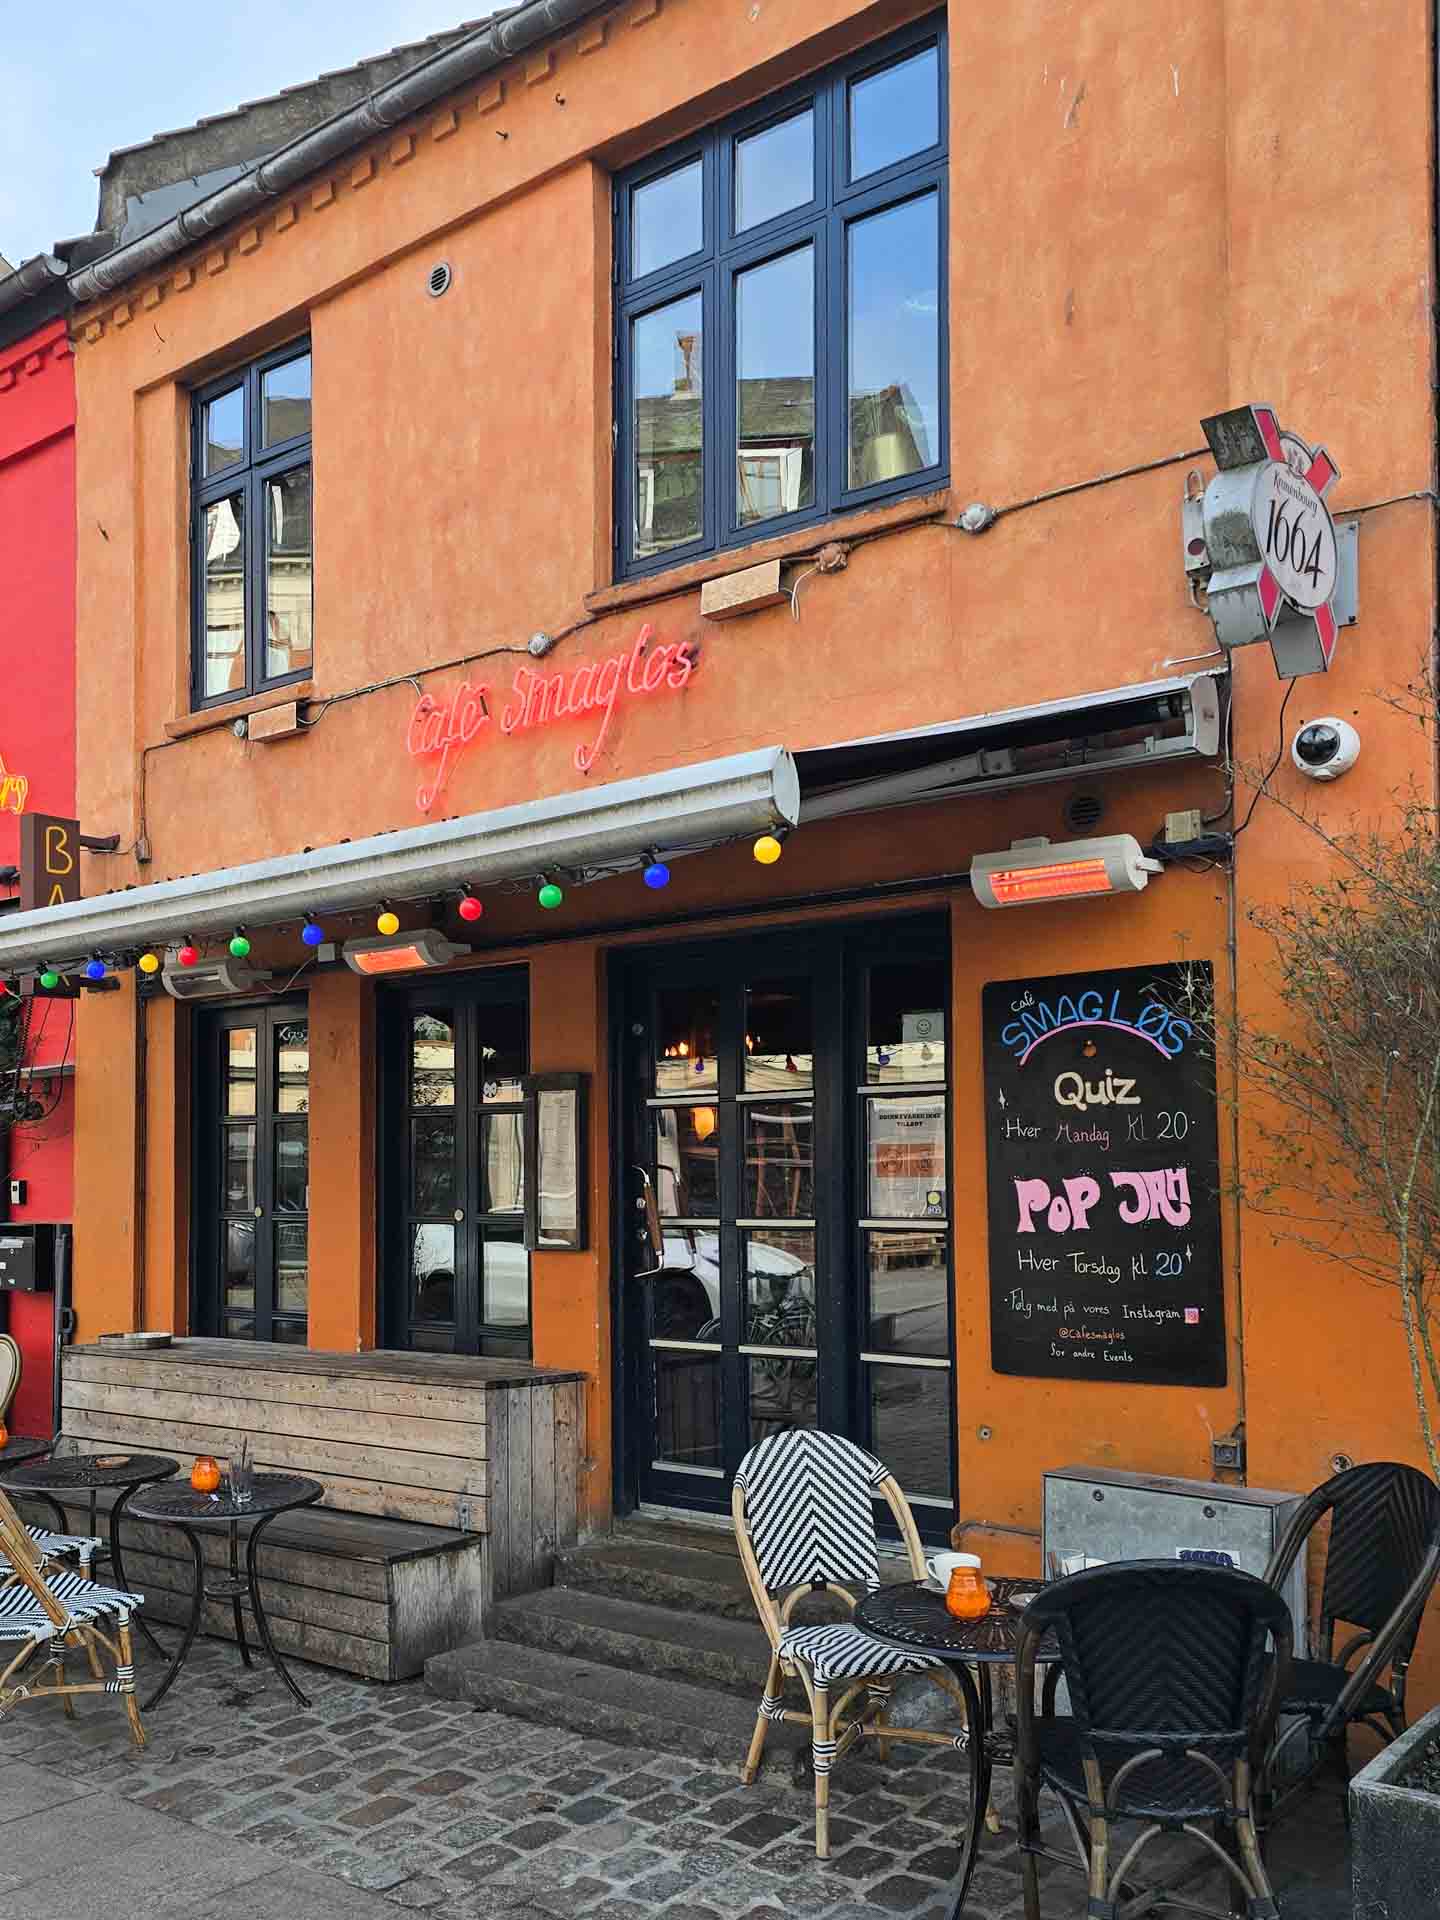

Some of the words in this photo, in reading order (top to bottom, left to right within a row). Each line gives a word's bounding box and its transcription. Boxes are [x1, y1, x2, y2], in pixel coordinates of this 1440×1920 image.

[1266, 499, 1325, 588] 1664
[1001, 989, 1192, 1057] SMAGLØS
[1054, 1068, 1141, 1111] Quiz
[1005, 1117, 1041, 1138] Hver
[1055, 1120, 1110, 1151] Mandag
[1157, 1110, 1188, 1140] 20
[1017, 1249, 1060, 1272] Hver
[1066, 1251, 1121, 1284] Torsdag
[1155, 1252, 1183, 1276] 20
[1036, 1296, 1058, 1314] med
[1063, 1301, 1076, 1320] på
[1083, 1304, 1110, 1315] vores
[1122, 1304, 1181, 1325] Instagram
[1073, 1346, 1096, 1359] andre
[1104, 1349, 1134, 1363] Events
